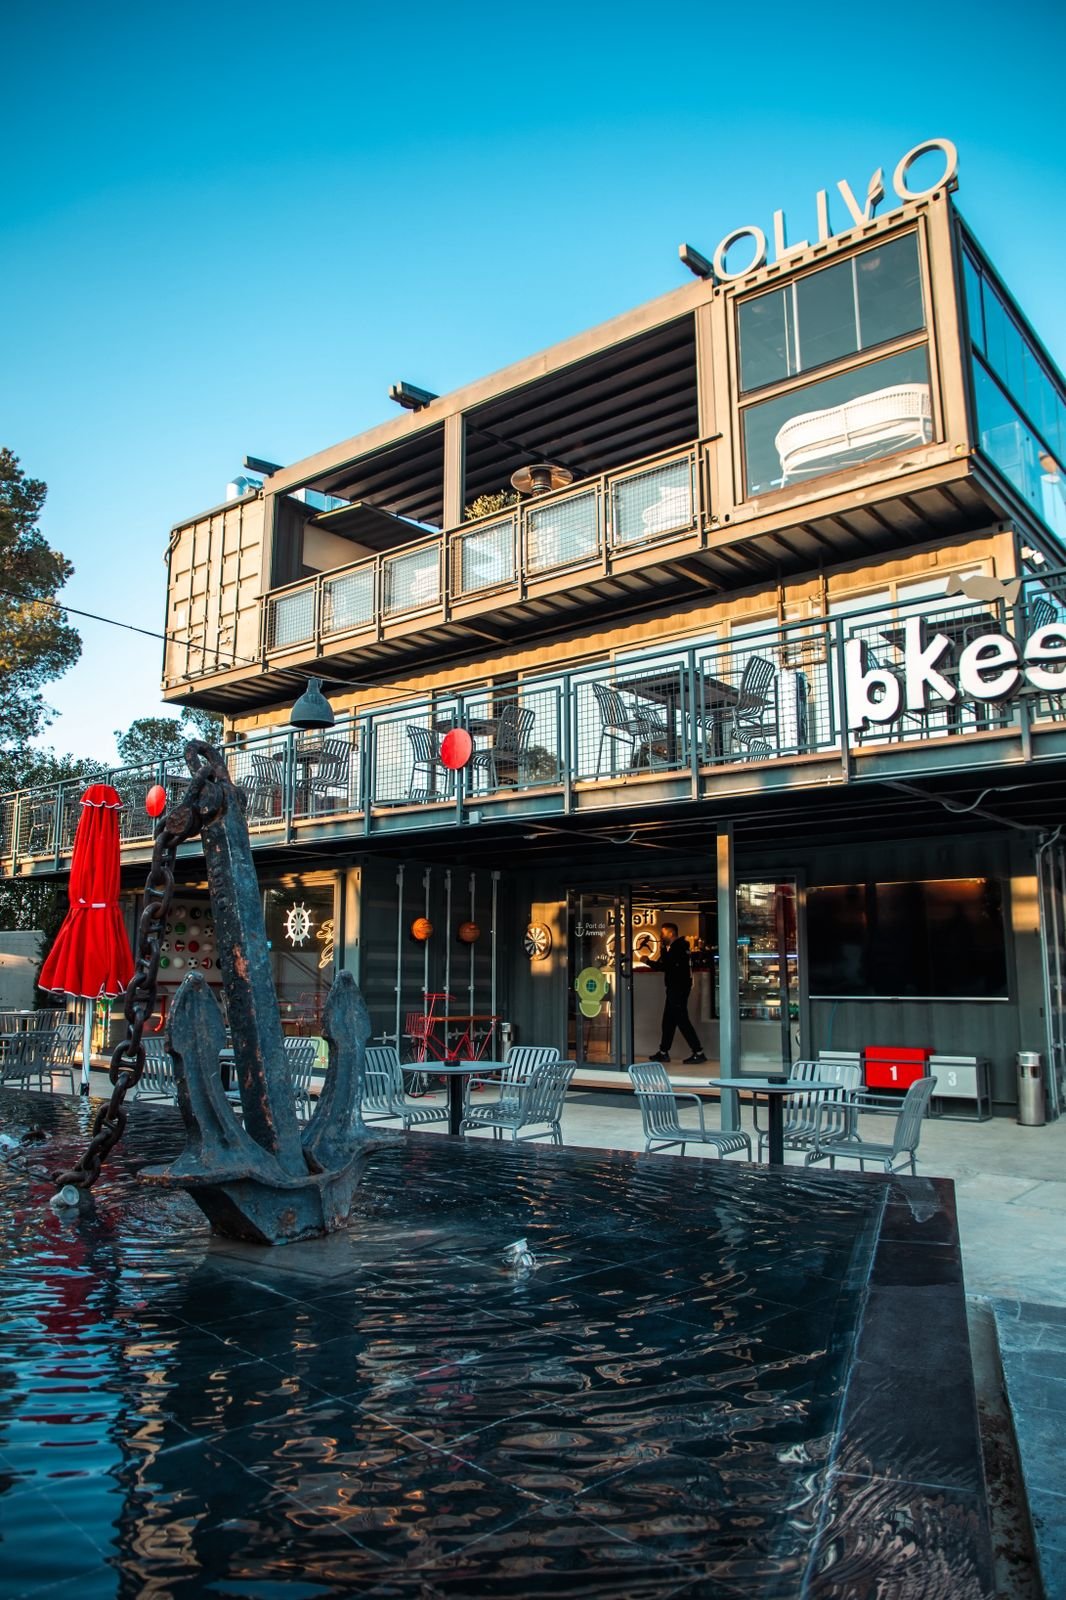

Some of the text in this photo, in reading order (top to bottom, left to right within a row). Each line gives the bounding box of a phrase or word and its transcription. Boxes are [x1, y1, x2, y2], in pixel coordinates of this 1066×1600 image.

[713, 138, 959, 282] OLIVO
[889, 1065, 898, 1081] 1
[948, 1071, 957, 1087] 3
